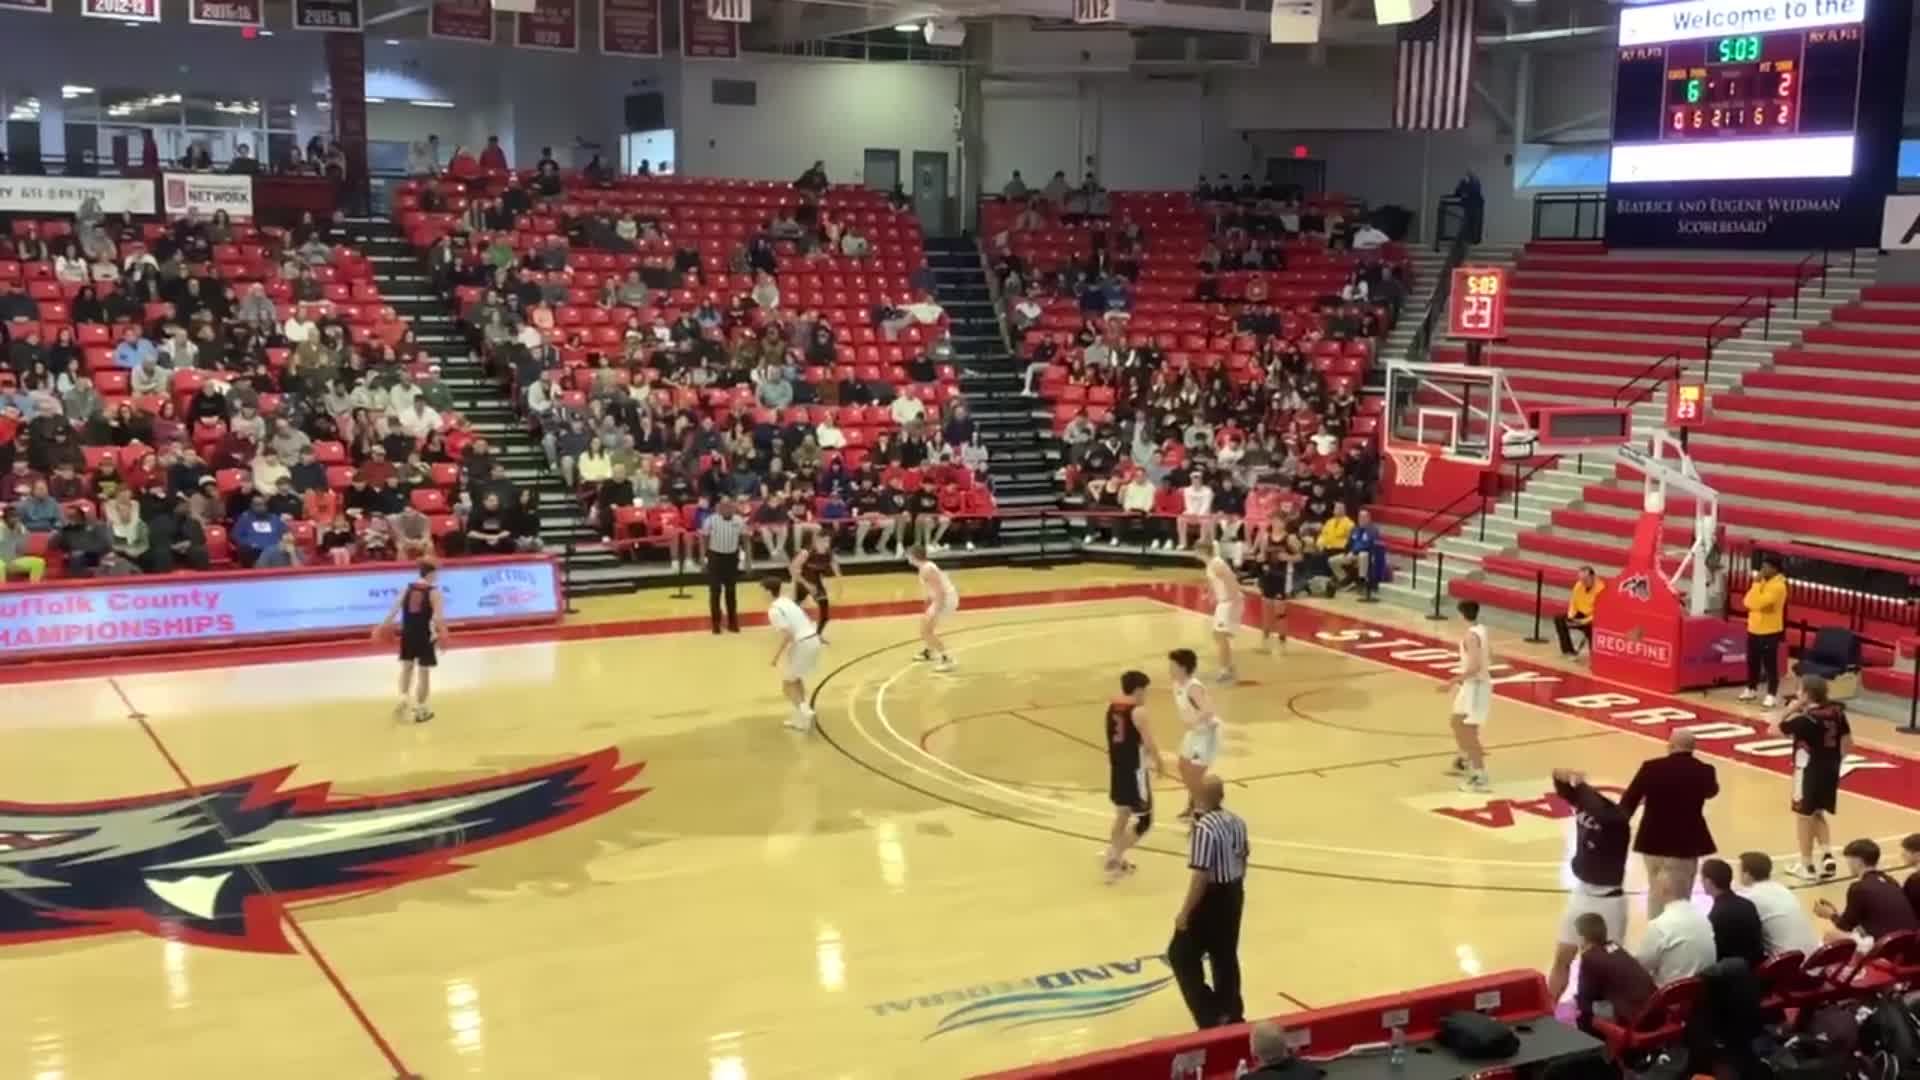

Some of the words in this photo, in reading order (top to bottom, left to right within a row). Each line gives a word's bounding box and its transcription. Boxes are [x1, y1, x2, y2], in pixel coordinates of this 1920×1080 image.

[1673, 6, 1776, 30] Welcome
[1784, 0, 1807, 20] to
[1815, 0, 1855, 17] the
[1720, 37, 1758, 62] 5:03
[1687, 80, 1700, 103] 6
[1779, 74, 1791, 96] 2
[1777, 105, 1789, 124] 2
[1616, 199, 1673, 214] BEATRICE
[1679, 200, 1707, 213] AND
[1710, 198, 1763, 213] EUGENE
[1767, 197, 1841, 212] WEIDMAN
[1468, 275, 1497, 294] 5:03
[1462, 296, 1491, 328] 23
[1677, 400, 1696, 418] 23
[107, 588, 220, 611] County
[1595, 633, 1668, 662] REDEFINE
[1112, 713, 1126, 743] 3
